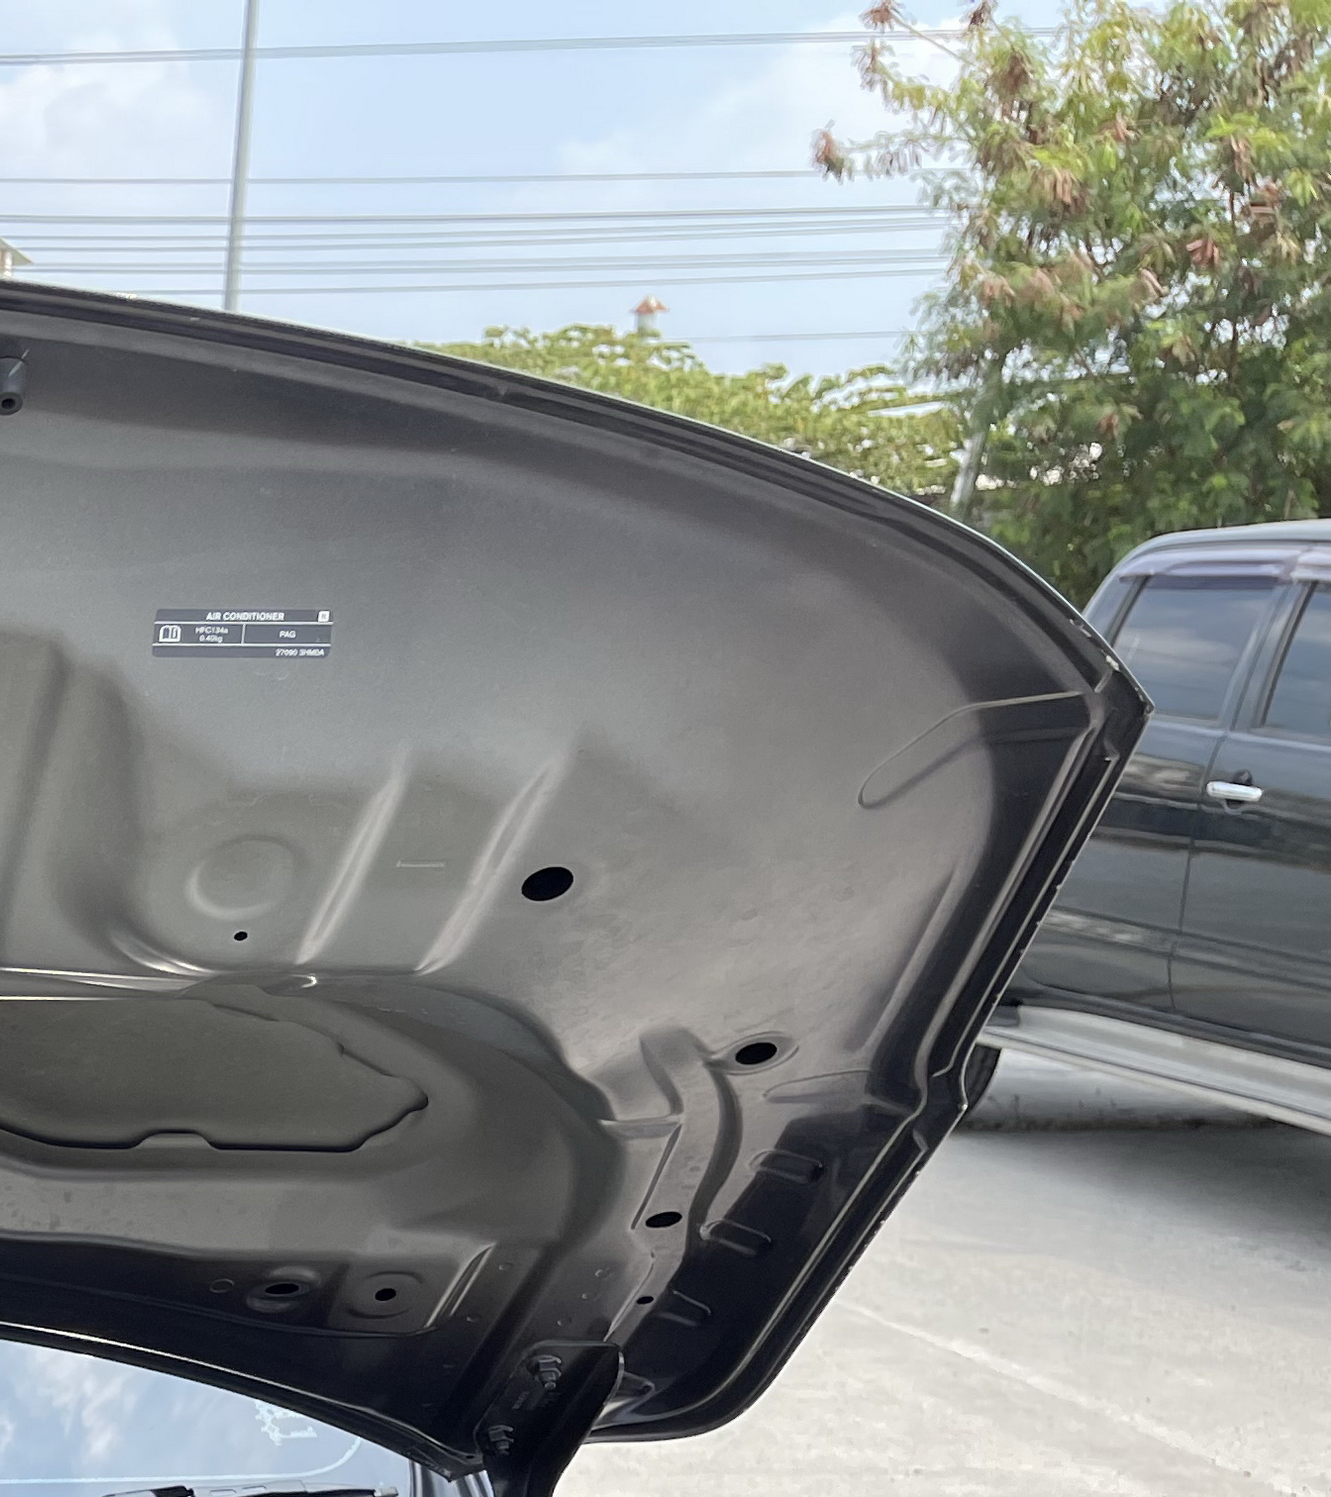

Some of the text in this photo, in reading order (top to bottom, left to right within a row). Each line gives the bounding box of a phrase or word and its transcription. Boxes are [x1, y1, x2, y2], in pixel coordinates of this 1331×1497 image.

[205, 612, 221, 620] AIR
[223, 612, 285, 621] CONDITIONER
[279, 630, 297, 638] PAG
